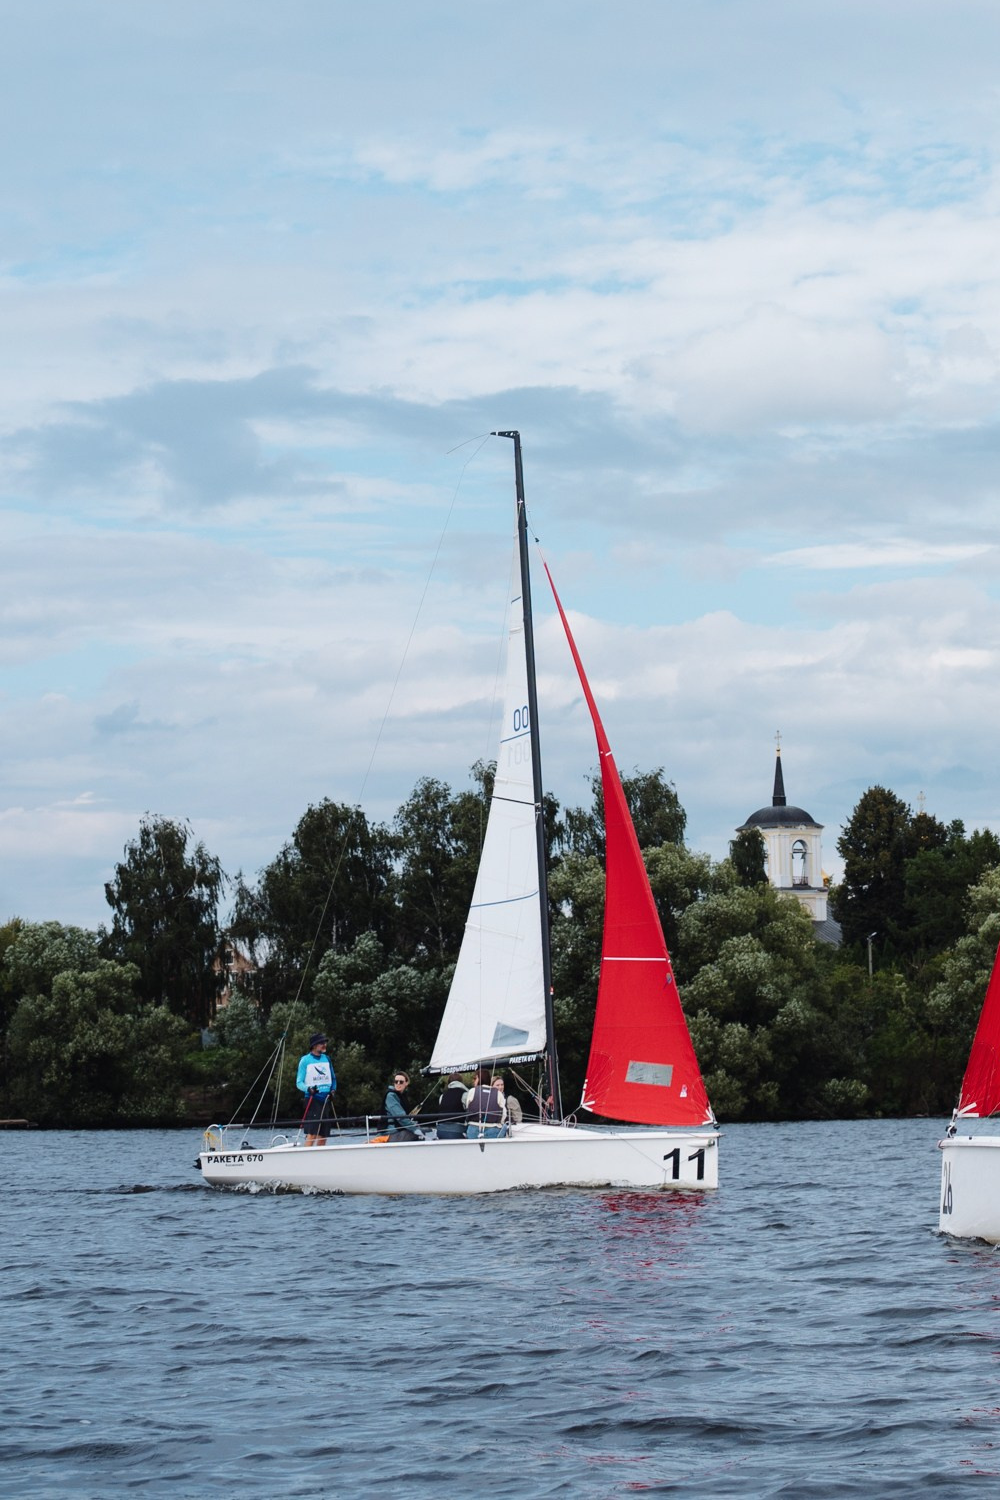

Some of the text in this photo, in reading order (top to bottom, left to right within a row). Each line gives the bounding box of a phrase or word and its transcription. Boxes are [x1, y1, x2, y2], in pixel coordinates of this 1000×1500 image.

[514, 705, 529, 732] 00
[247, 1154, 264, 1162] 670
[663, 1148, 705, 1180] 11
[943, 1161, 953, 1215] 26
